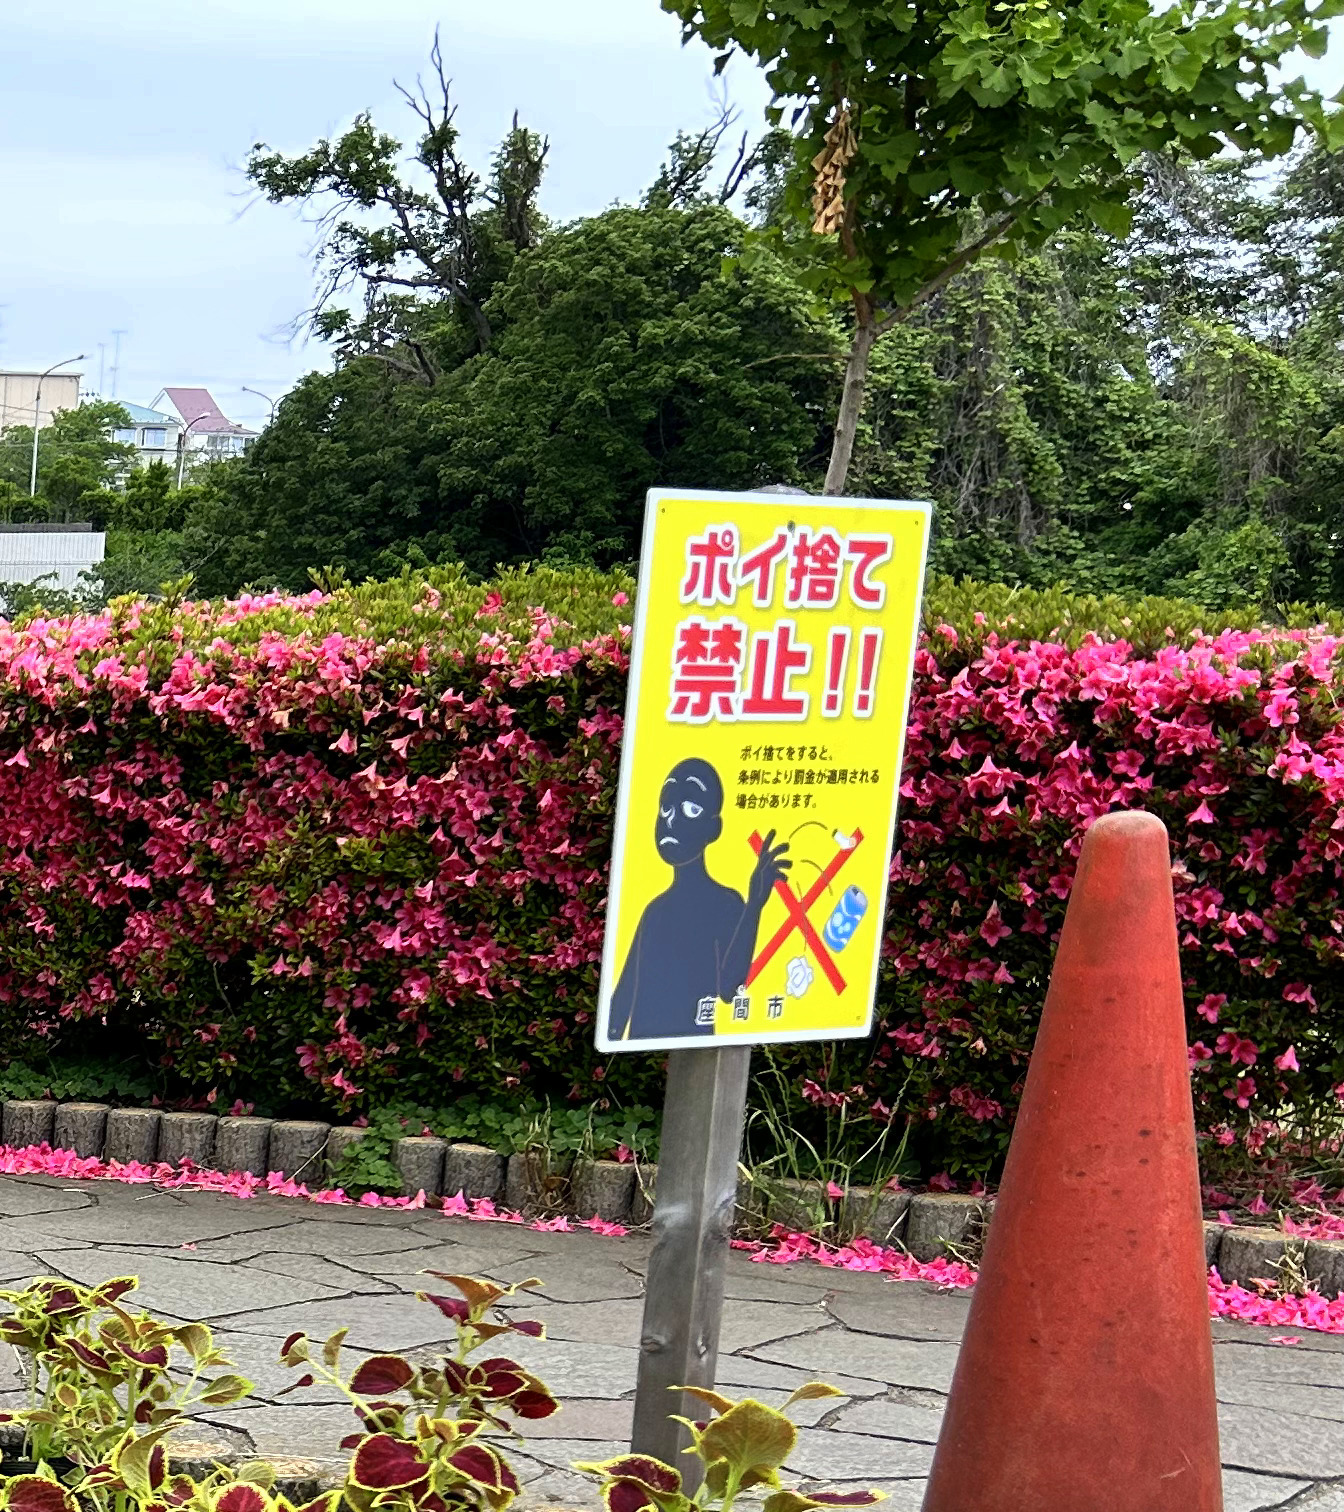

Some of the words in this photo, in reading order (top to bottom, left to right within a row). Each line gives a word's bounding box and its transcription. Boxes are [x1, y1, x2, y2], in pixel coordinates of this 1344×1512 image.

[683, 528, 890, 605] ポイ捨て
[669, 621, 880, 717] 禁止!!
[739, 744, 834, 762] ポイ捨てをすると、
[736, 768, 880, 785] 条例により罰金が適用される
[735, 792, 818, 809] 場合があります。
